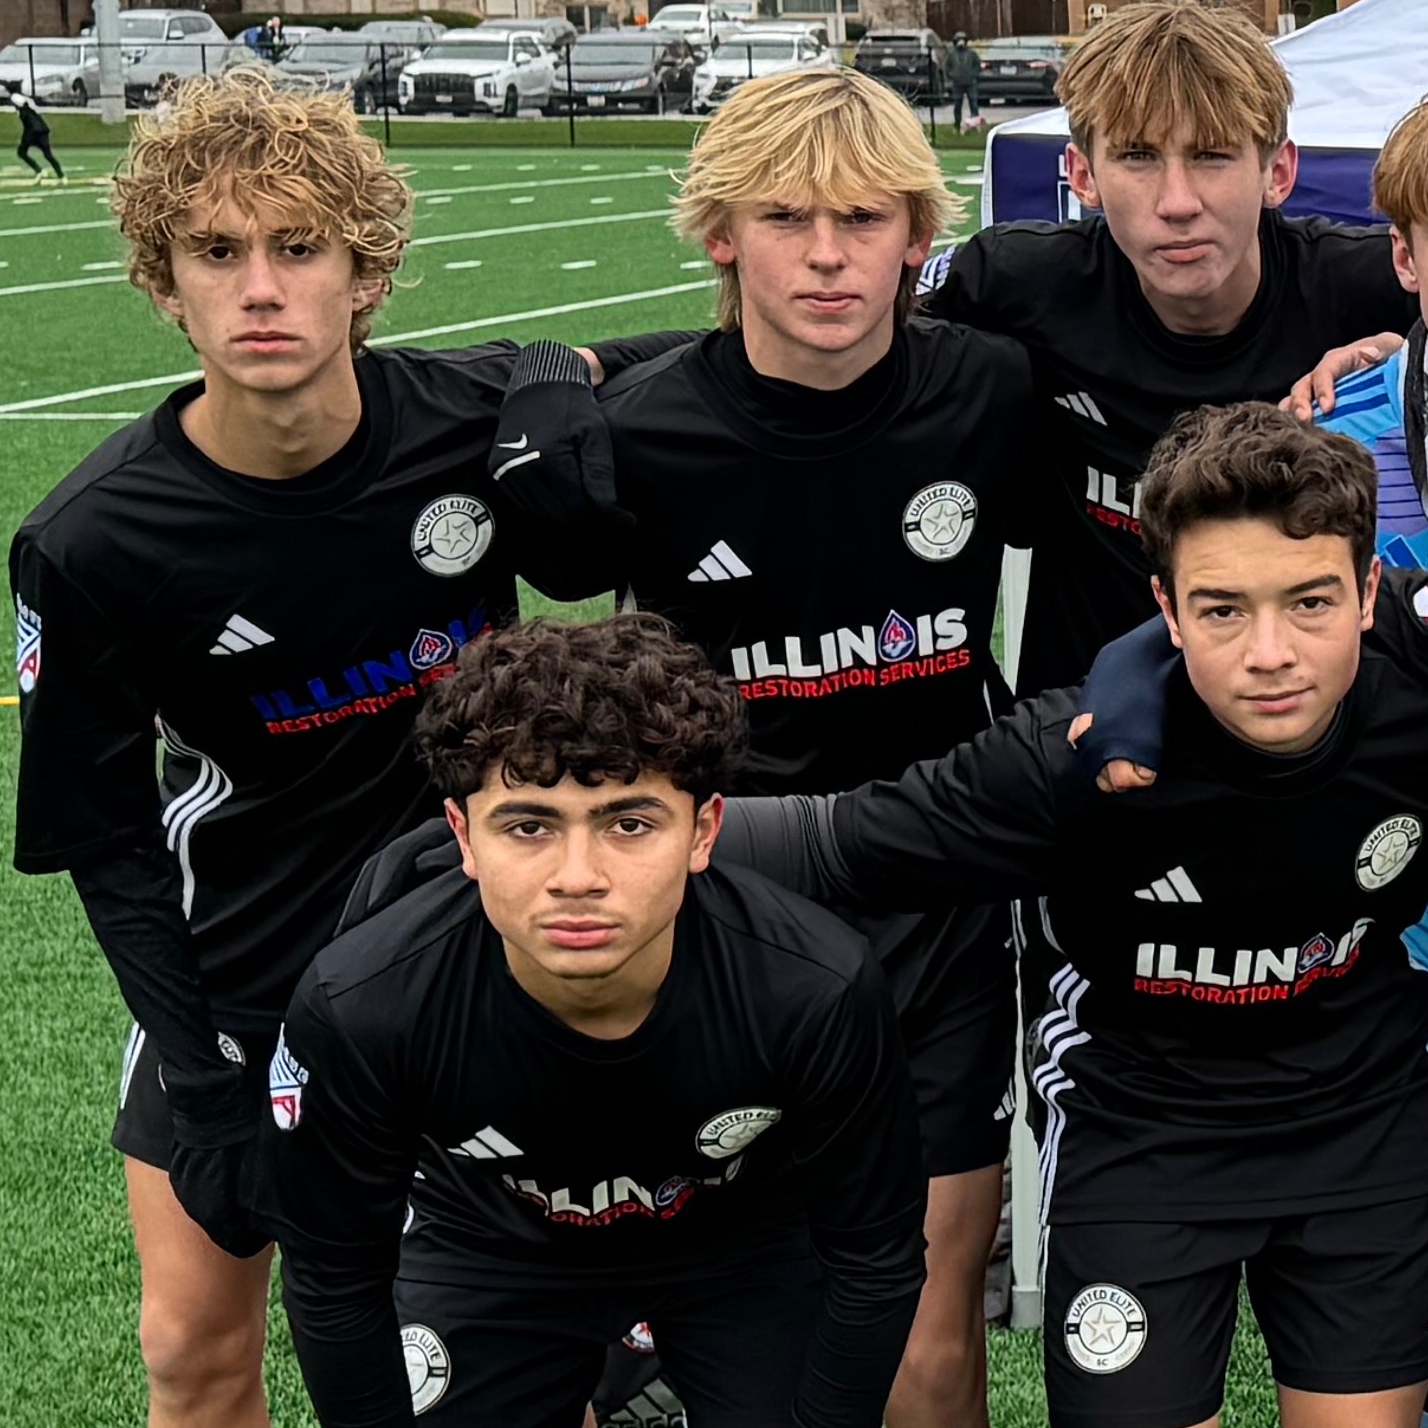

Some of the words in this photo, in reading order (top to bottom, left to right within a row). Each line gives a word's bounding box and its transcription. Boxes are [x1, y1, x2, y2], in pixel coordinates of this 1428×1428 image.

[738, 669, 876, 700] RESTORATION
[879, 649, 971, 687] SERVICES
[1134, 978, 1289, 1004] RESTORATION
